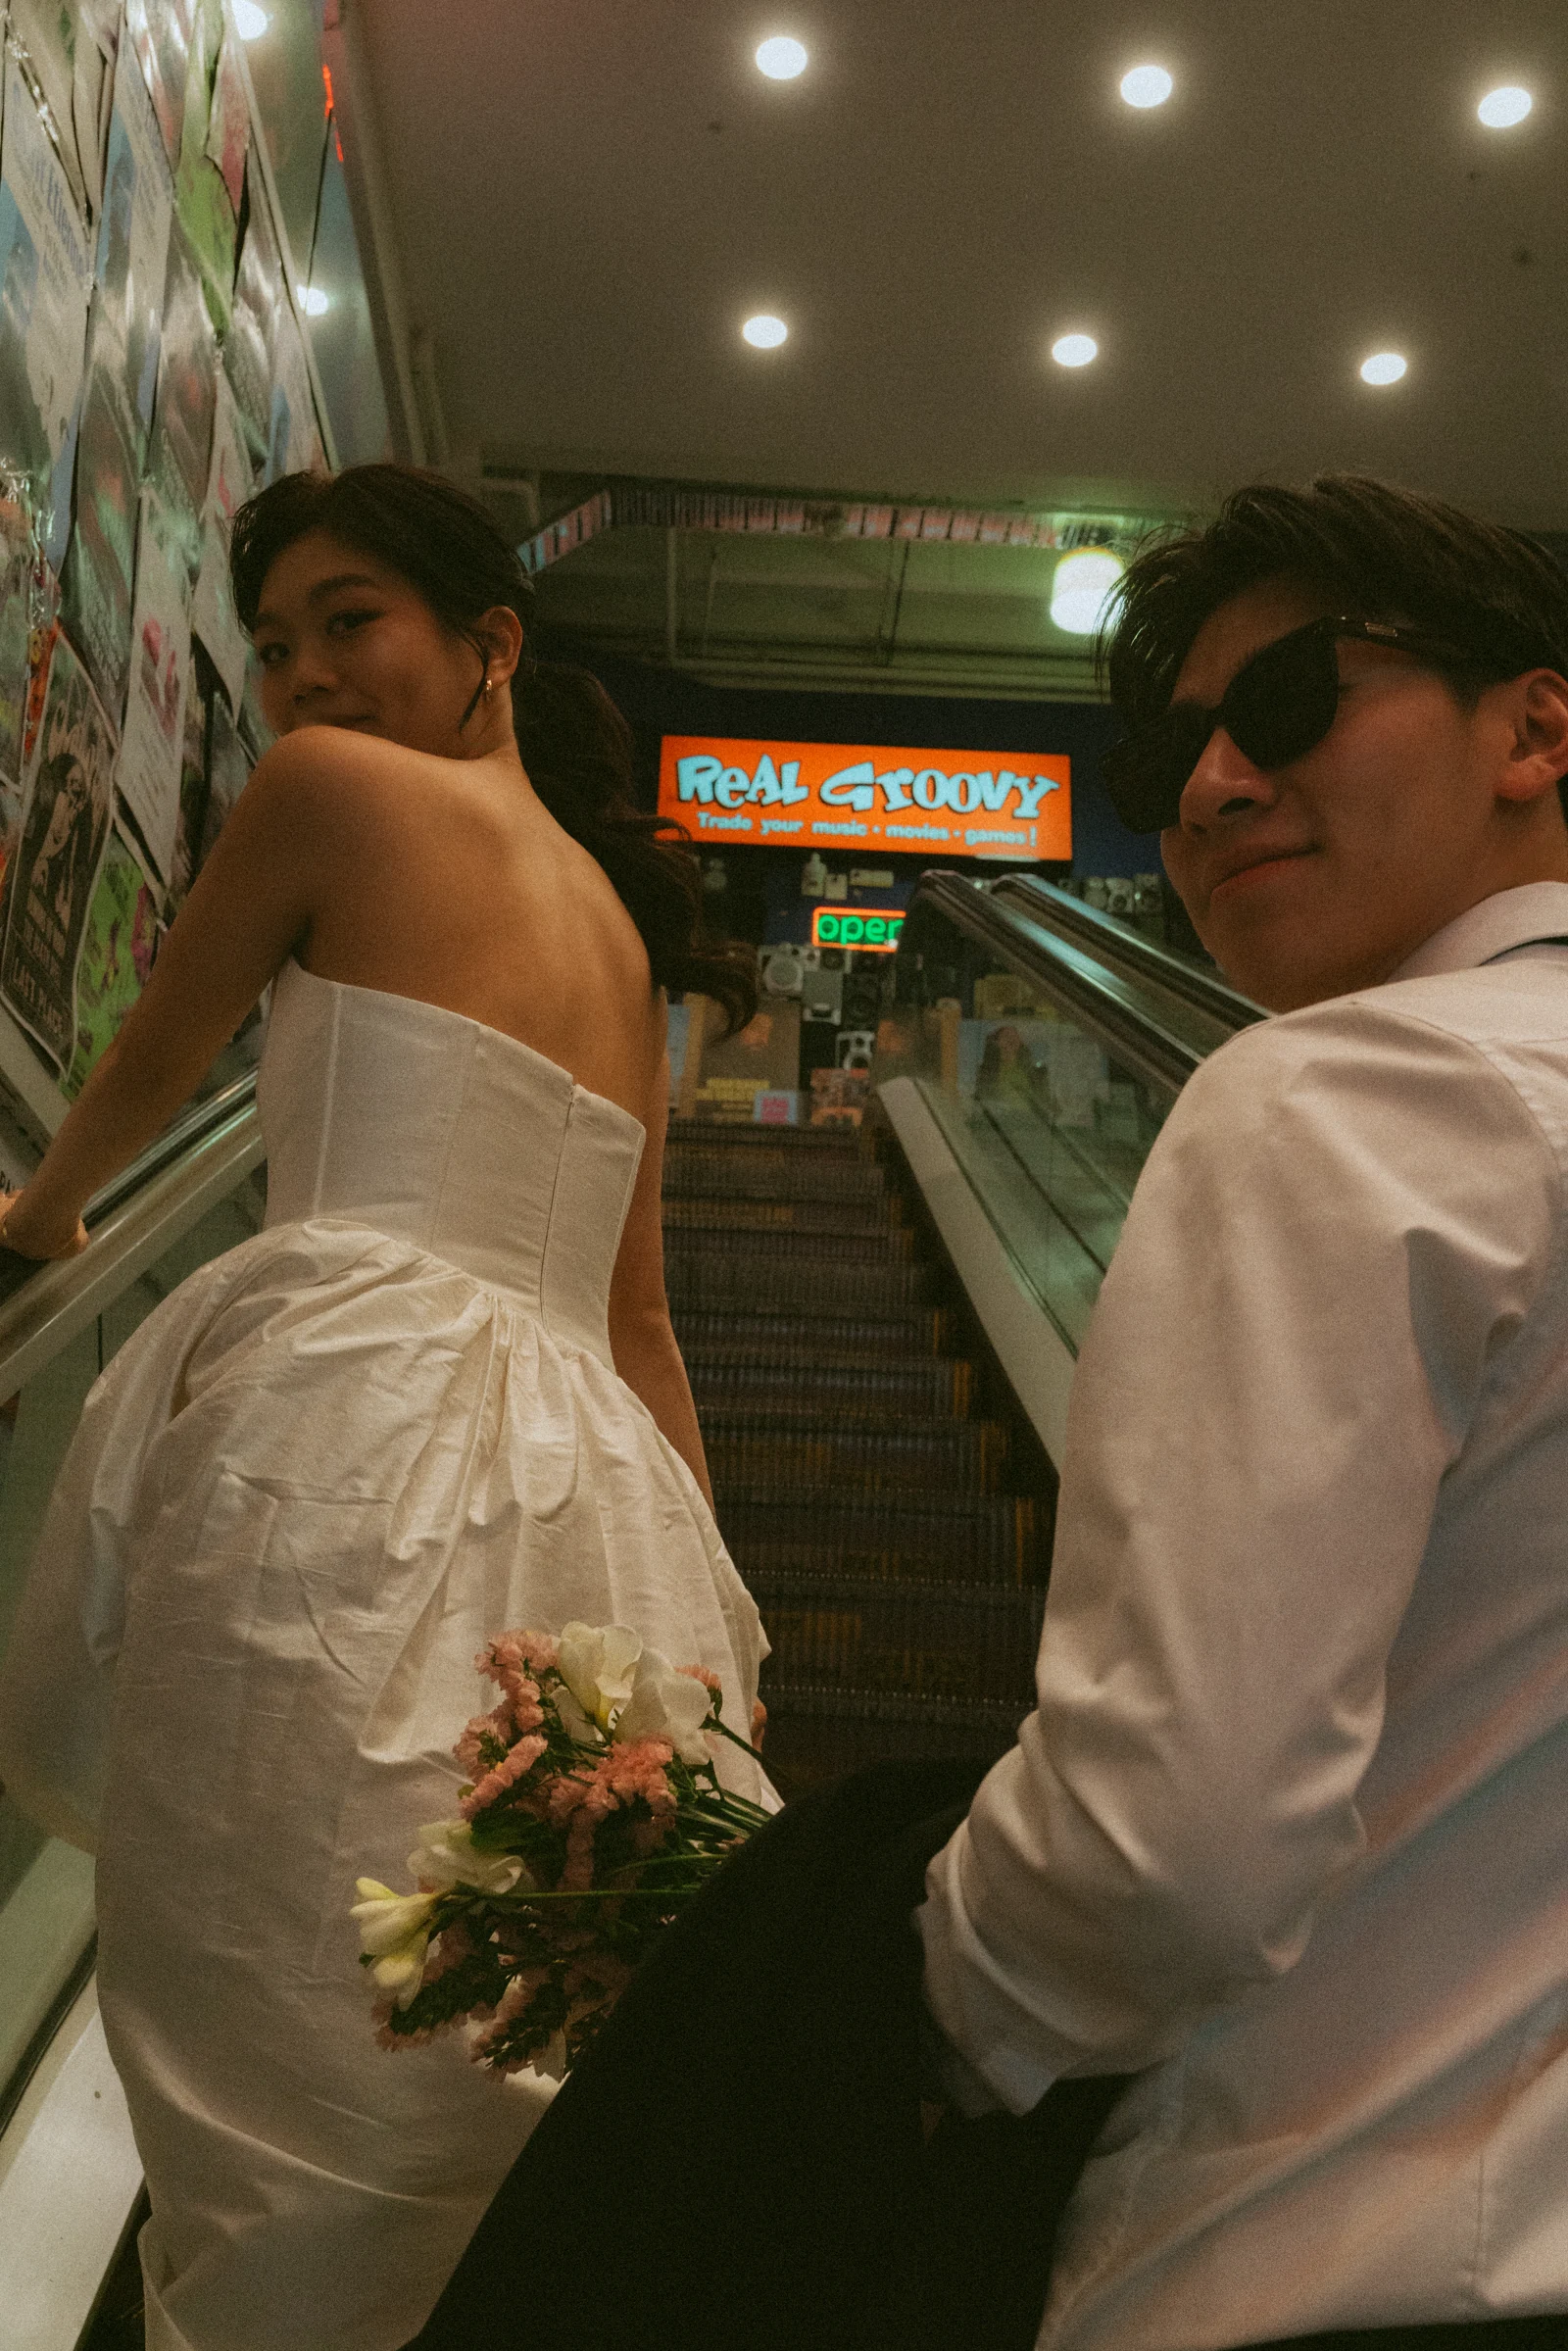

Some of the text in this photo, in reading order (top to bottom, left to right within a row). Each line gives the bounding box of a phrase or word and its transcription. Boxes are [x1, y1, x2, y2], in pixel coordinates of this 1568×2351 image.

[697, 810, 753, 831] Trade
[760, 817, 804, 837] your
[811, 819, 868, 837] music
[885, 822, 951, 841] movies
